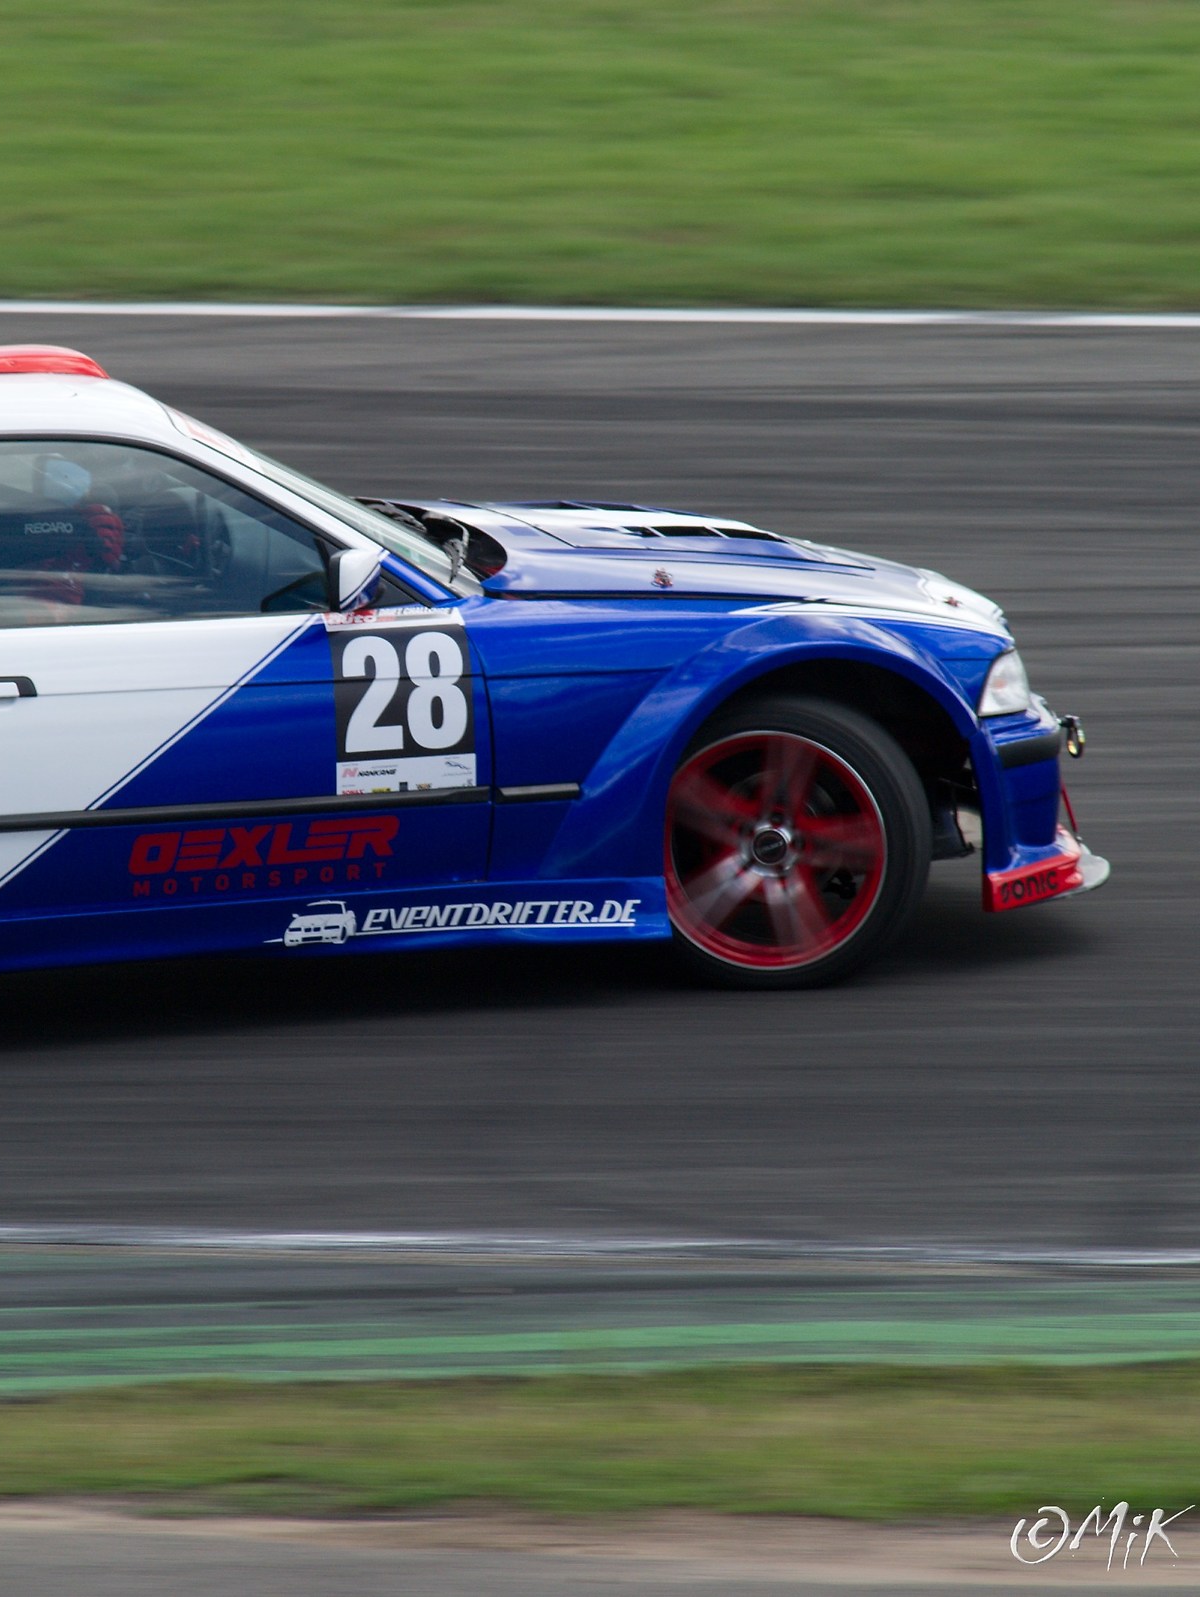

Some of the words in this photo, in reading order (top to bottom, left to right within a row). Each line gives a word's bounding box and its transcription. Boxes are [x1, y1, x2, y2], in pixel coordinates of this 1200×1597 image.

[24, 521, 74, 535] RECARO
[342, 631, 468, 753] 28
[128, 815, 400, 875] OEXLER
[132, 862, 387, 897] MOTORSPORT
